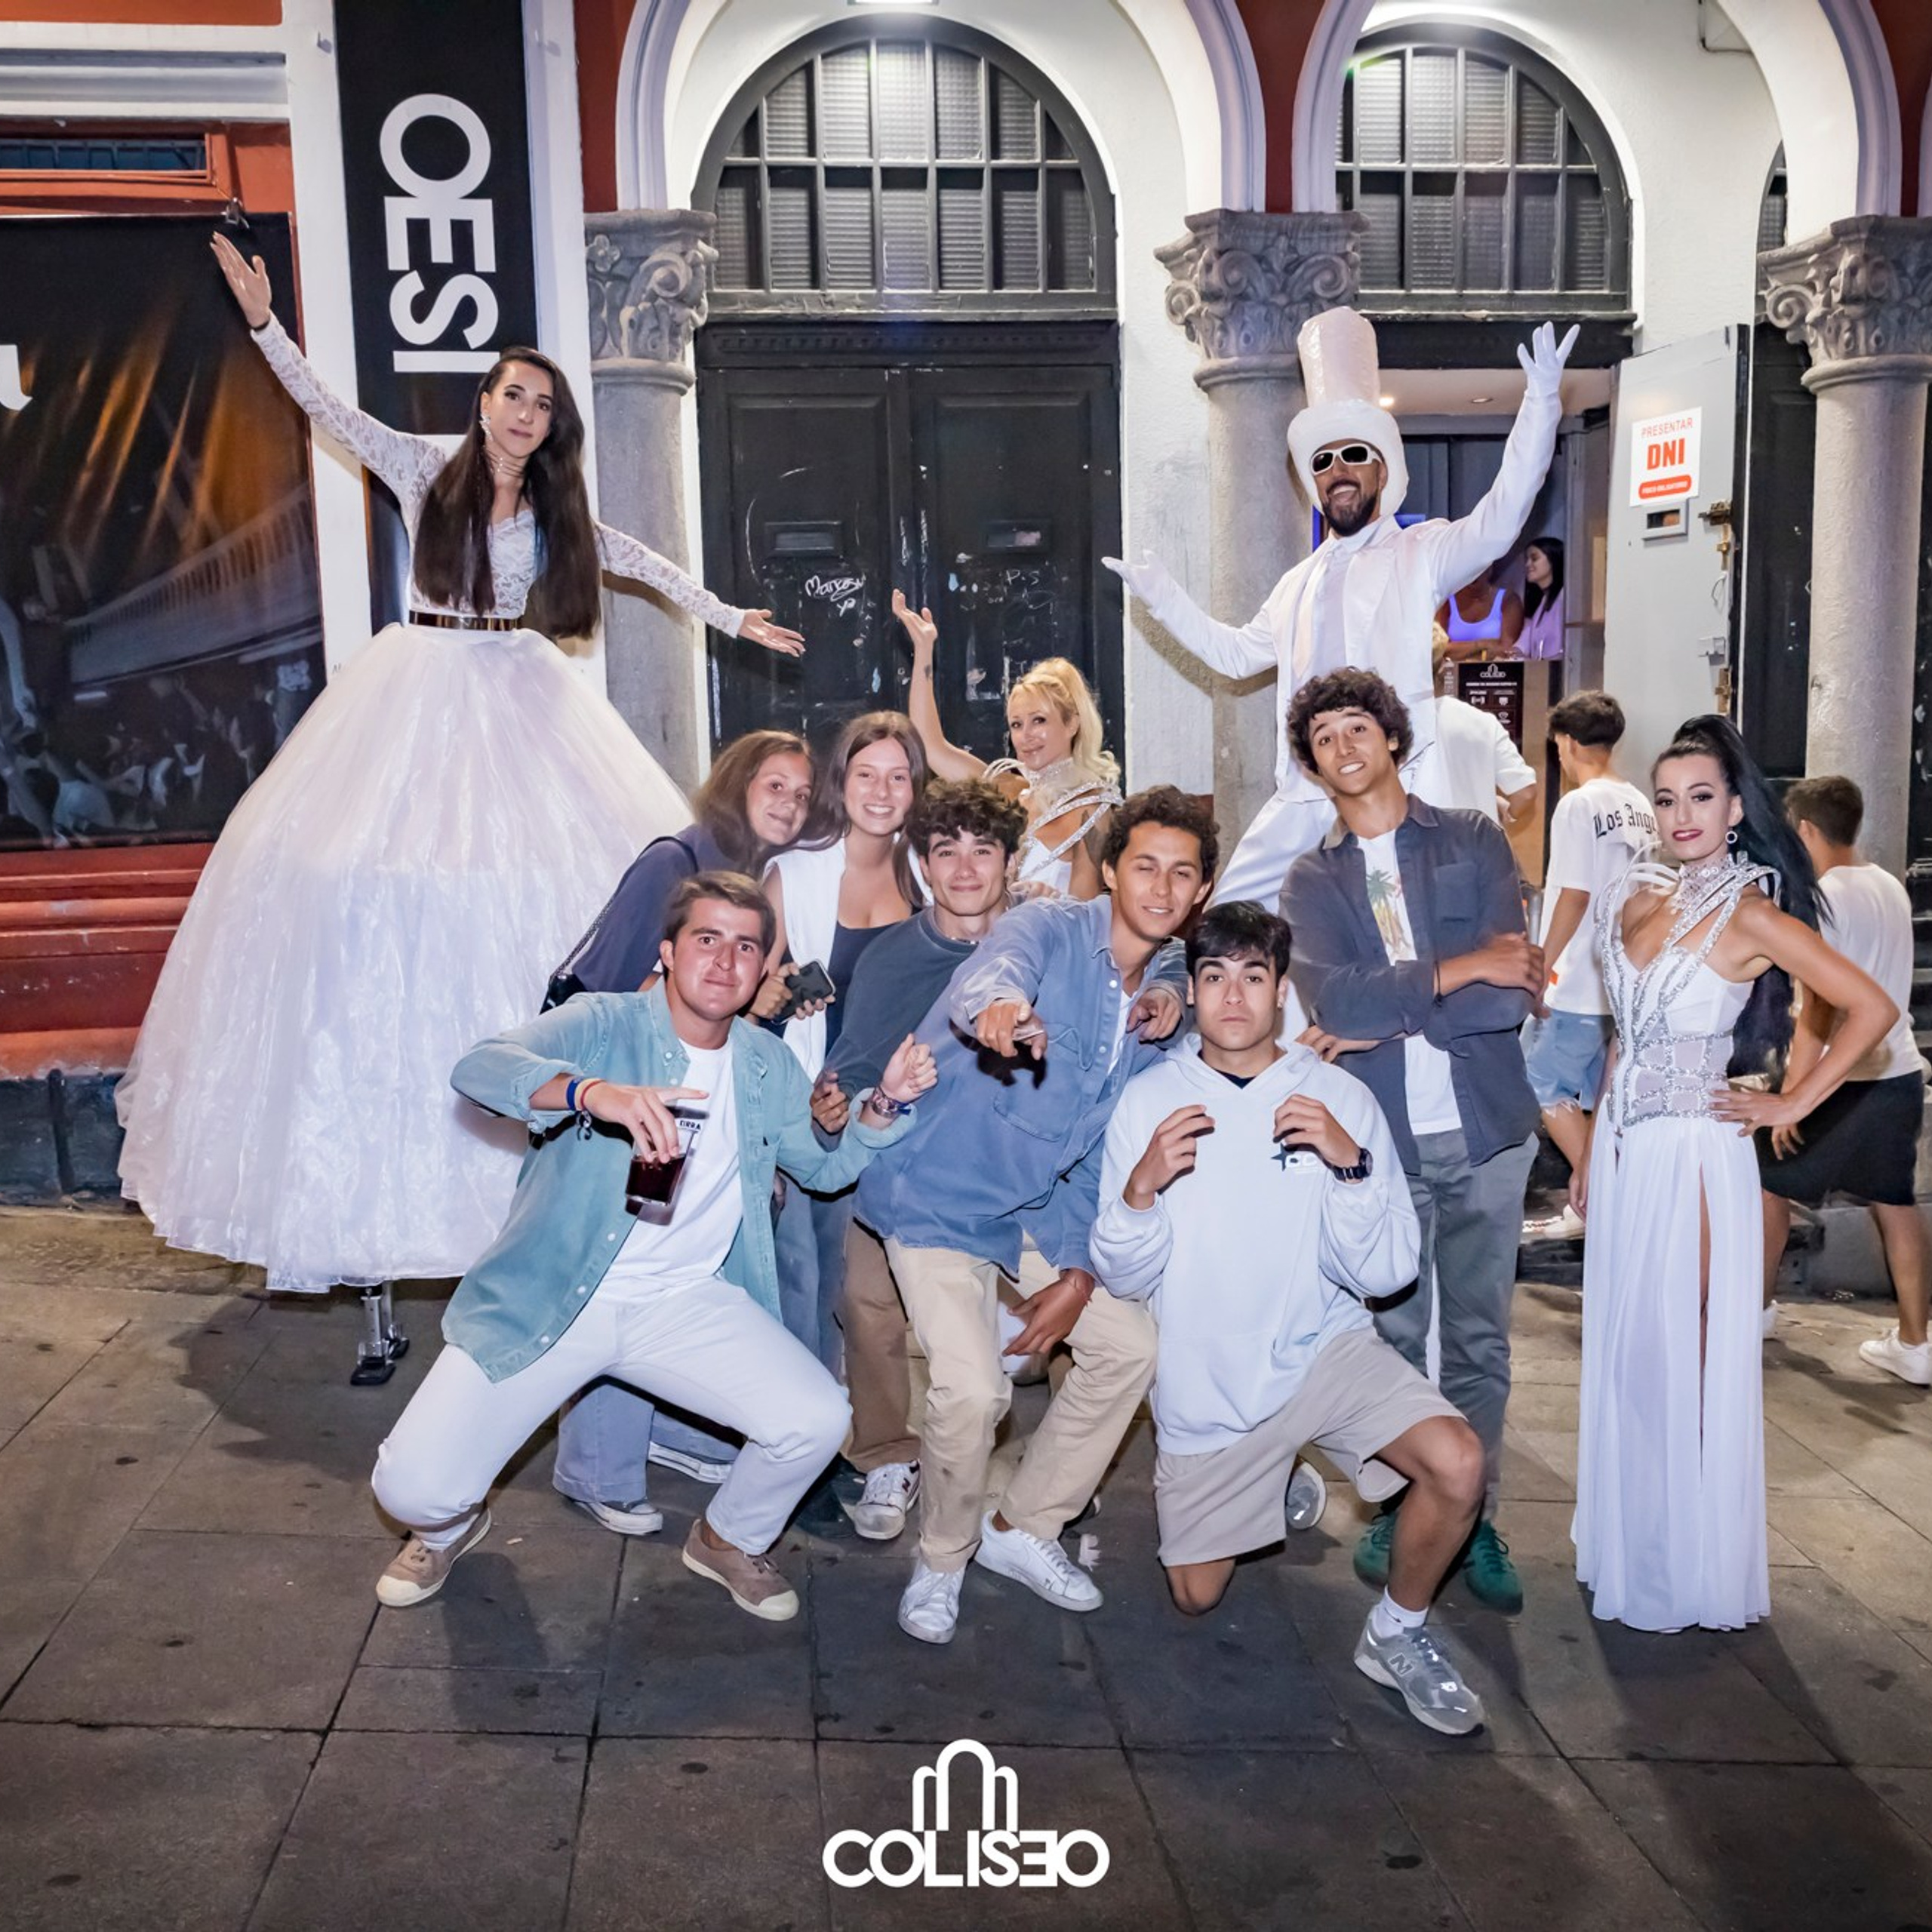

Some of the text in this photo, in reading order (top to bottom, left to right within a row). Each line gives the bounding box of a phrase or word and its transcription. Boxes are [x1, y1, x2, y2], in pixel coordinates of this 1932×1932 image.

[1641, 417, 1694, 438] PRESENTAR
[1646, 438, 1686, 470] DNI
[1593, 810, 1623, 839] Los
